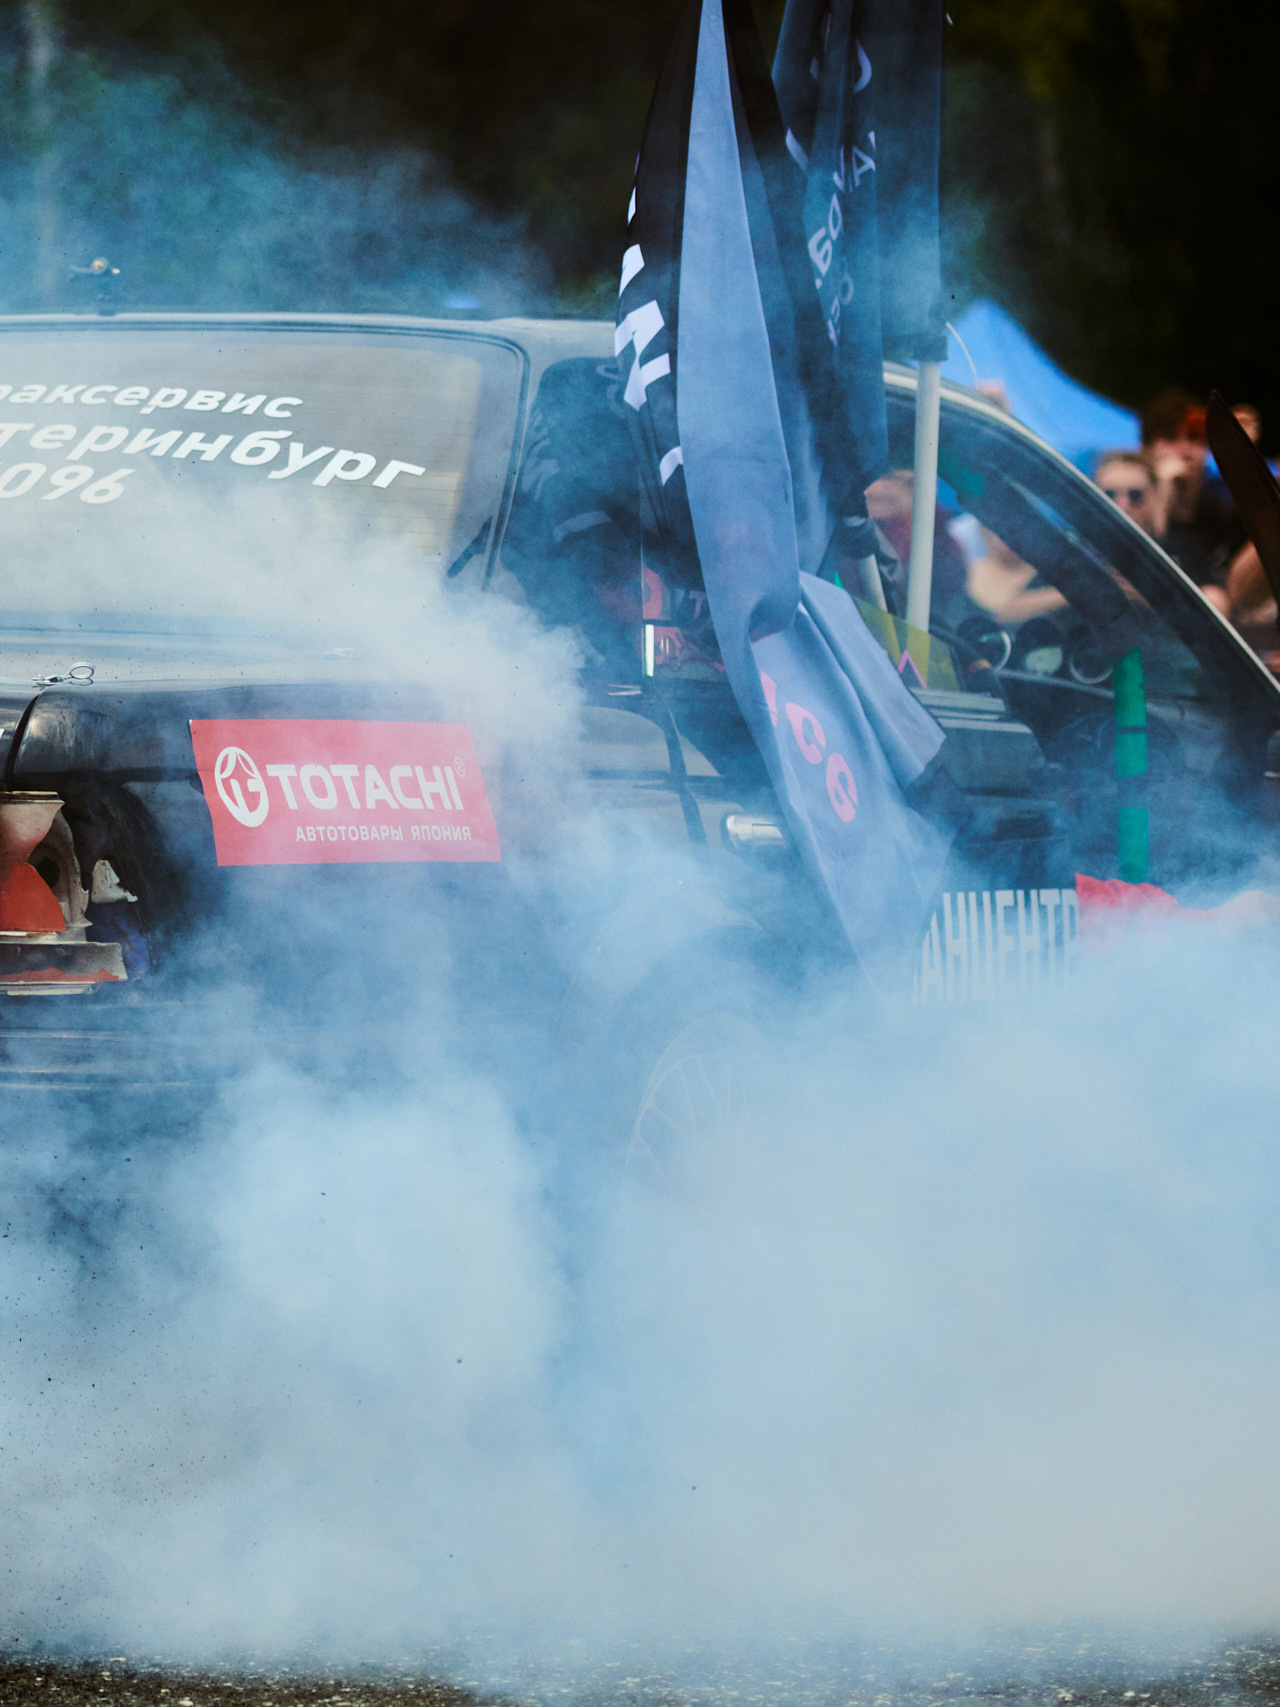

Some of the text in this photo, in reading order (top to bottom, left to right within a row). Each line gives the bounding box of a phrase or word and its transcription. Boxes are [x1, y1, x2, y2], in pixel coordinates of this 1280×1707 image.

[266, 764, 465, 811] TOTACHI
[295, 825, 472, 842] АВТОТОВАРЫ ЯПОНИЯ
